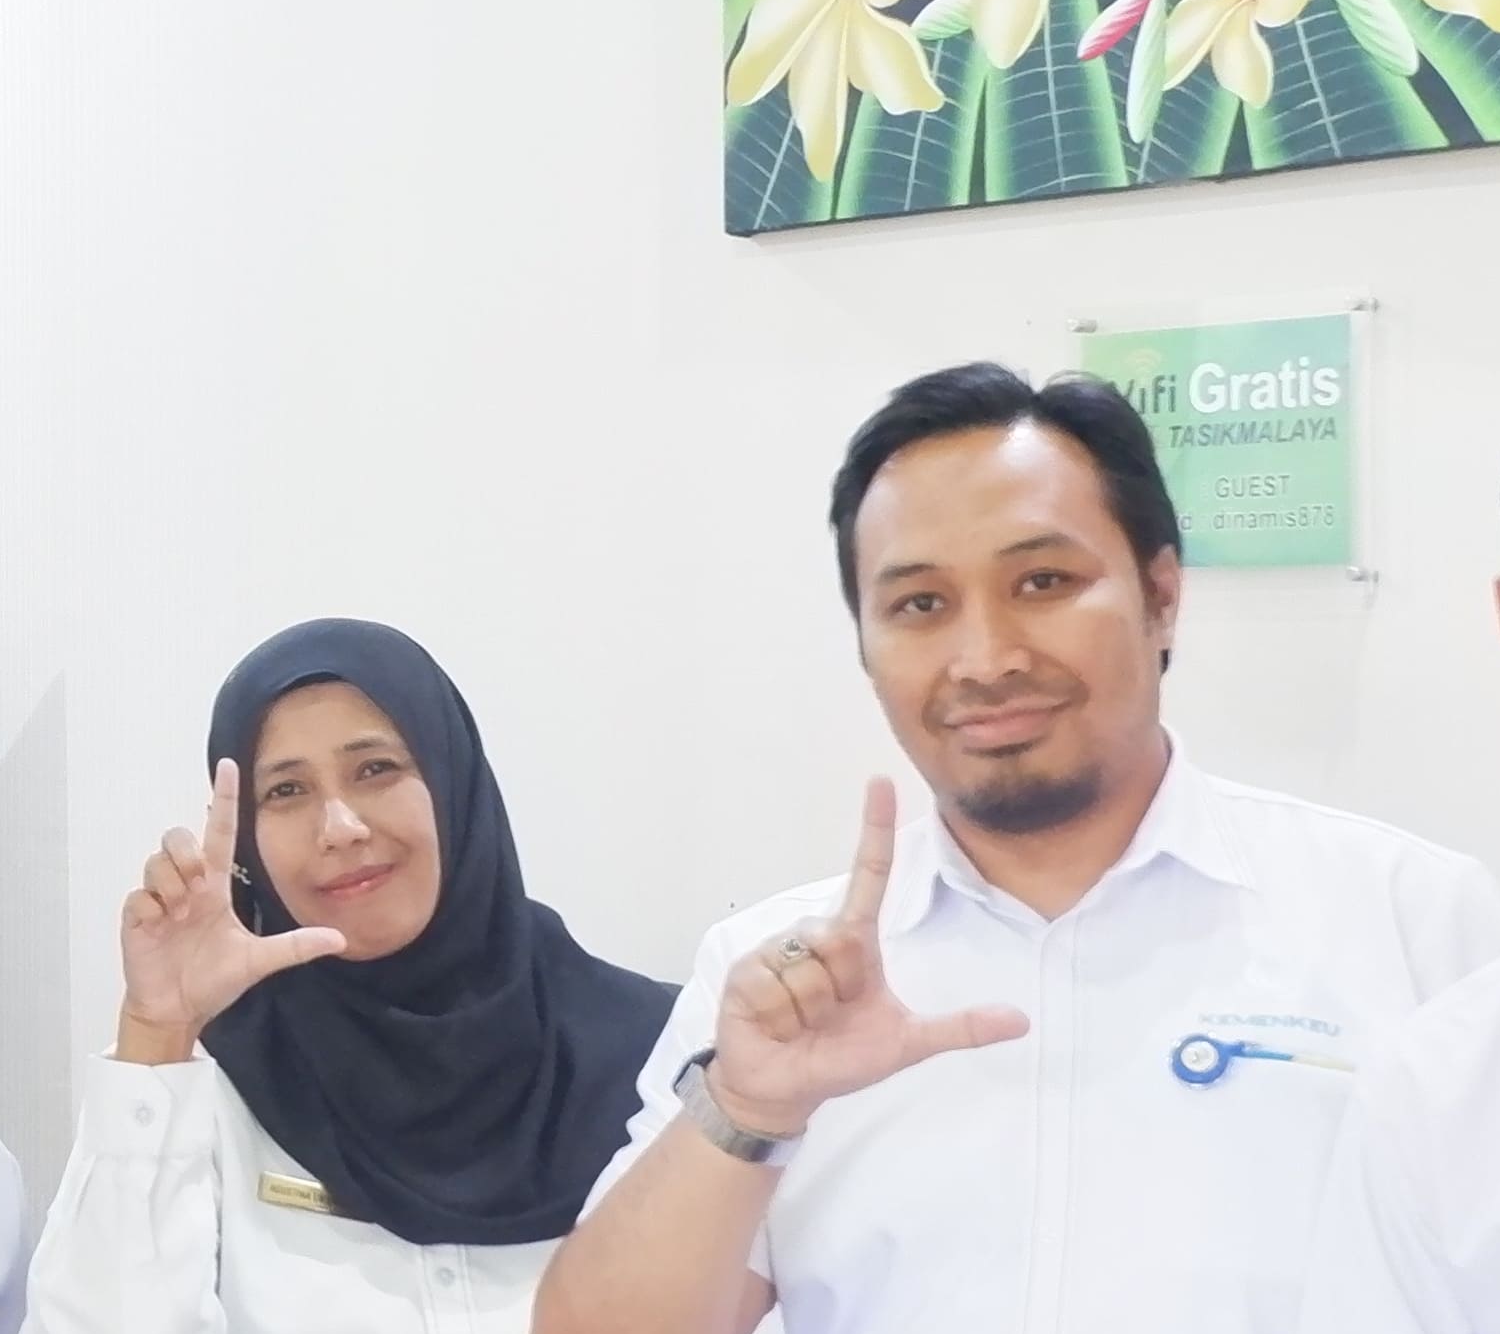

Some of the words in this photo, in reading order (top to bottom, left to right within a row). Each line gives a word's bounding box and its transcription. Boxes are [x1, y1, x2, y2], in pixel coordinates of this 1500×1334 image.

[1122, 374, 1176, 414] ifi
[1188, 356, 1342, 414] Gratis
[1168, 417, 1337, 448] TASIKMALAYA
[1214, 474, 1291, 499] GUEST
